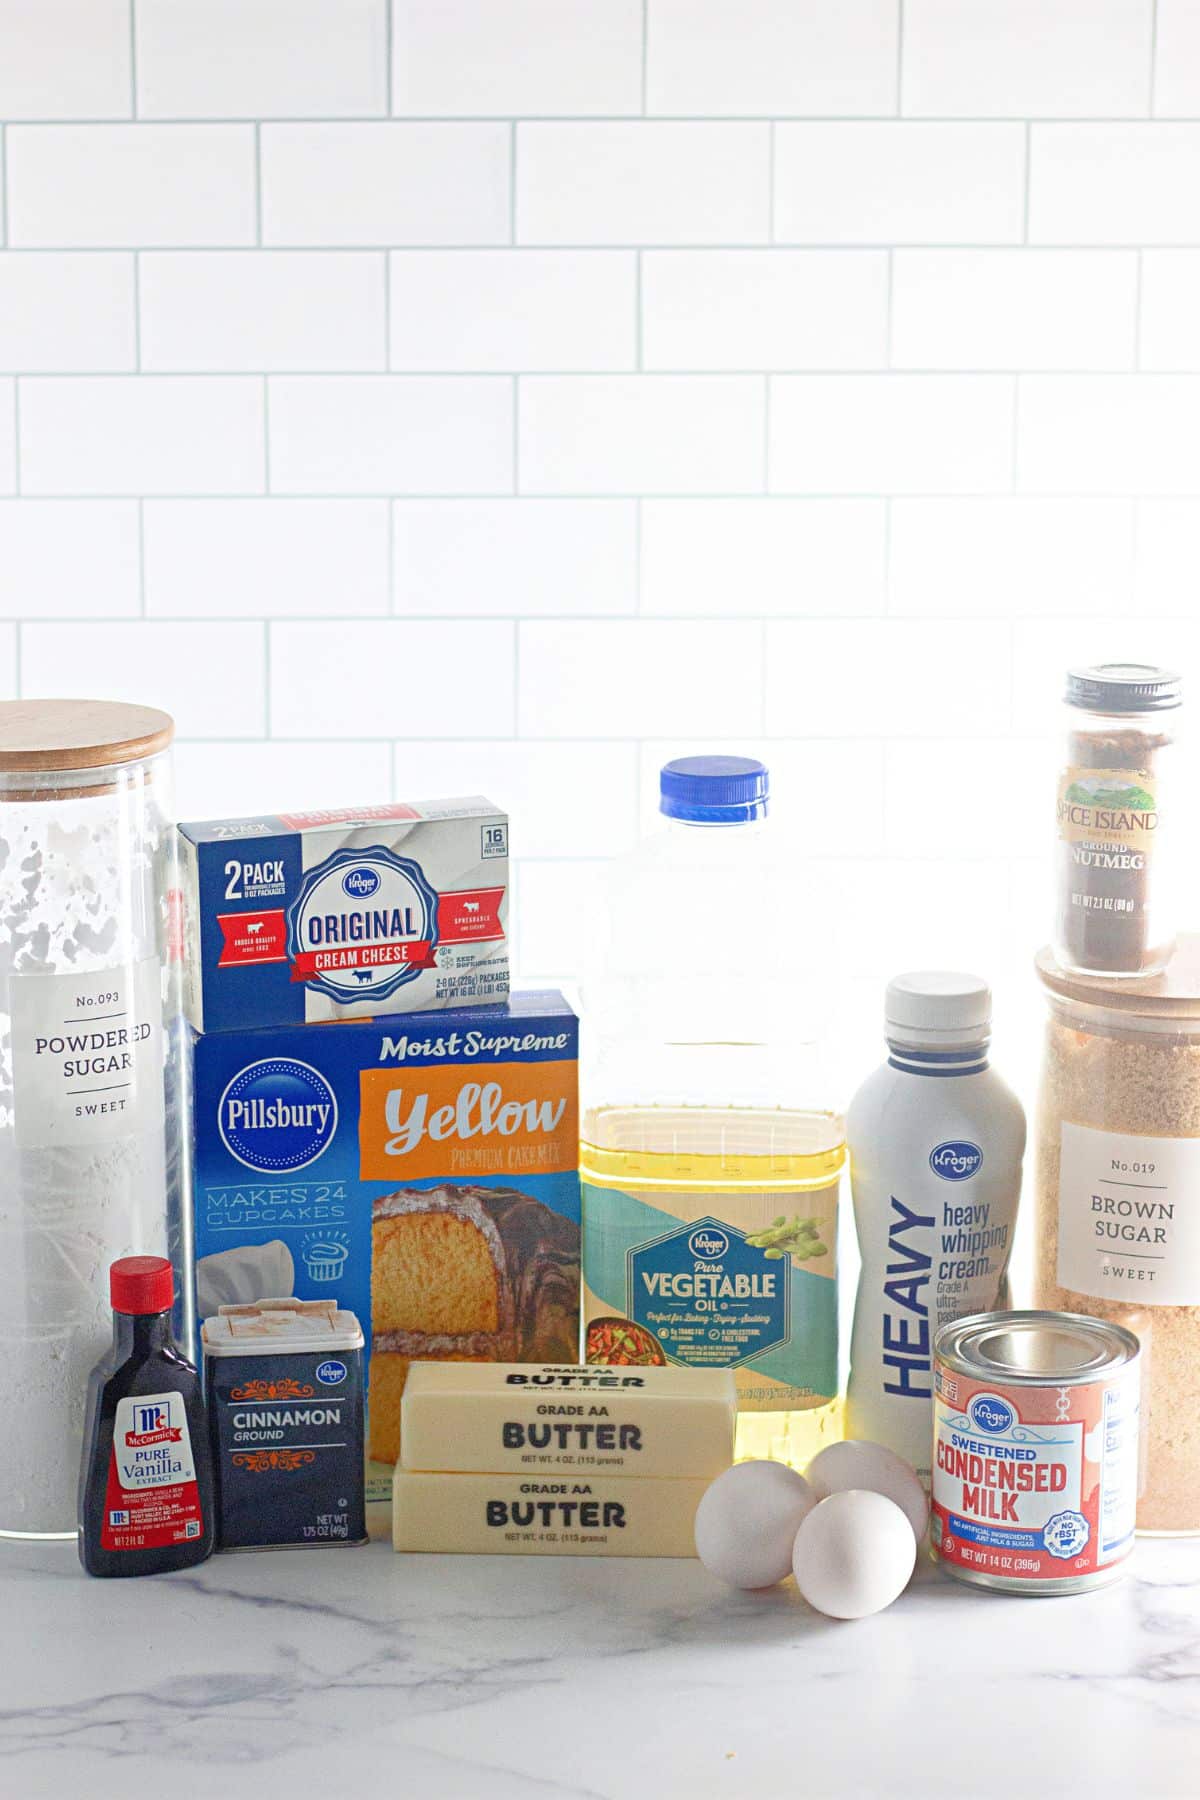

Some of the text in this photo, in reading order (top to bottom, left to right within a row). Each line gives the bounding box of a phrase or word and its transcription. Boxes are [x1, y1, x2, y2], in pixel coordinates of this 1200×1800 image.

[1056, 800, 1090, 826] SPICE
[485, 829, 502, 842] 16
[1072, 849, 1144, 869] NUTMEG
[224, 860, 285, 900] 2 PACK
[348, 873, 375, 893] Kroger
[308, 907, 417, 945] ORIGINAL
[315, 945, 408, 969] CREAM CHEESE
[480, 971, 510, 983] PACKAGES
[76, 992, 119, 1007] No.093
[436, 989, 448, 998] NET
[450, 987, 459, 997] WT
[35, 1023, 151, 1054] POWDERED
[379, 1031, 569, 1061] Moist Supreme
[64, 1053, 133, 1077] SUGAR
[75, 1100, 126, 1116] SWEET
[227, 1098, 331, 1135] Pillsbury
[384, 1082, 567, 1156] Yellow
[450, 1146, 504, 1171] PREMIUM
[934, 1149, 979, 1173] Kroger
[1111, 1159, 1155, 1174] No.019
[207, 1186, 347, 1210] MAKES 24
[1091, 1195, 1174, 1219] BROWN
[206, 1206, 345, 1225] CUPCAKES
[943, 1202, 990, 1228] heavy
[941, 1224, 1008, 1257] whipping
[1096, 1221, 1167, 1243] SUGAR
[695, 1233, 724, 1254] Kroger
[694, 1261, 723, 1273] Pure
[939, 1257, 990, 1280] cream
[1103, 1266, 1156, 1281] SWEET
[642, 1272, 776, 1298] VEGETABLE
[937, 1281, 961, 1294] Grade
[695, 1300, 718, 1312] OIL
[883, 1195, 936, 1399] HEAVY
[321, 1365, 343, 1380] Kroger
[506, 1374, 645, 1388] BUTTER
[232, 1409, 341, 1429] CINNAMON
[536, 1405, 609, 1416] GRADE AA
[974, 1404, 1009, 1427] Kroger
[128, 1430, 176, 1446] McCormick
[233, 1430, 284, 1441] GROUND
[502, 1422, 643, 1451] BUTTER
[135, 1448, 170, 1462] PURE
[951, 1433, 1037, 1461] SWEETENED
[123, 1460, 182, 1478] Vanilla
[521, 1455, 537, 1463] NET
[539, 1455, 553, 1464] WT.
[555, 1456, 561, 1464] 4
[562, 1456, 575, 1464] OZ.
[597, 1457, 624, 1466] grams)
[937, 1440, 1067, 1492] CONDENSED
[137, 1475, 172, 1485] EXTRACT
[519, 1484, 592, 1494] GRADE AA
[962, 1484, 1019, 1522] MILK
[317, 1513, 348, 1524] NET WT
[486, 1501, 626, 1528] BUTTER
[317, 1526, 329, 1536] OZ
[505, 1533, 520, 1541] NET
[521, 1533, 535, 1542] WT.
[538, 1534, 544, 1542] 4
[546, 1534, 559, 1542] OZ.
[961, 1523, 990, 1537] ARTIFICIAL
[1055, 1528, 1077, 1538] rBST
[990, 1537, 1005, 1545] MILK
[961, 1547, 1040, 1572] NET WT 14 OZ (396g)
